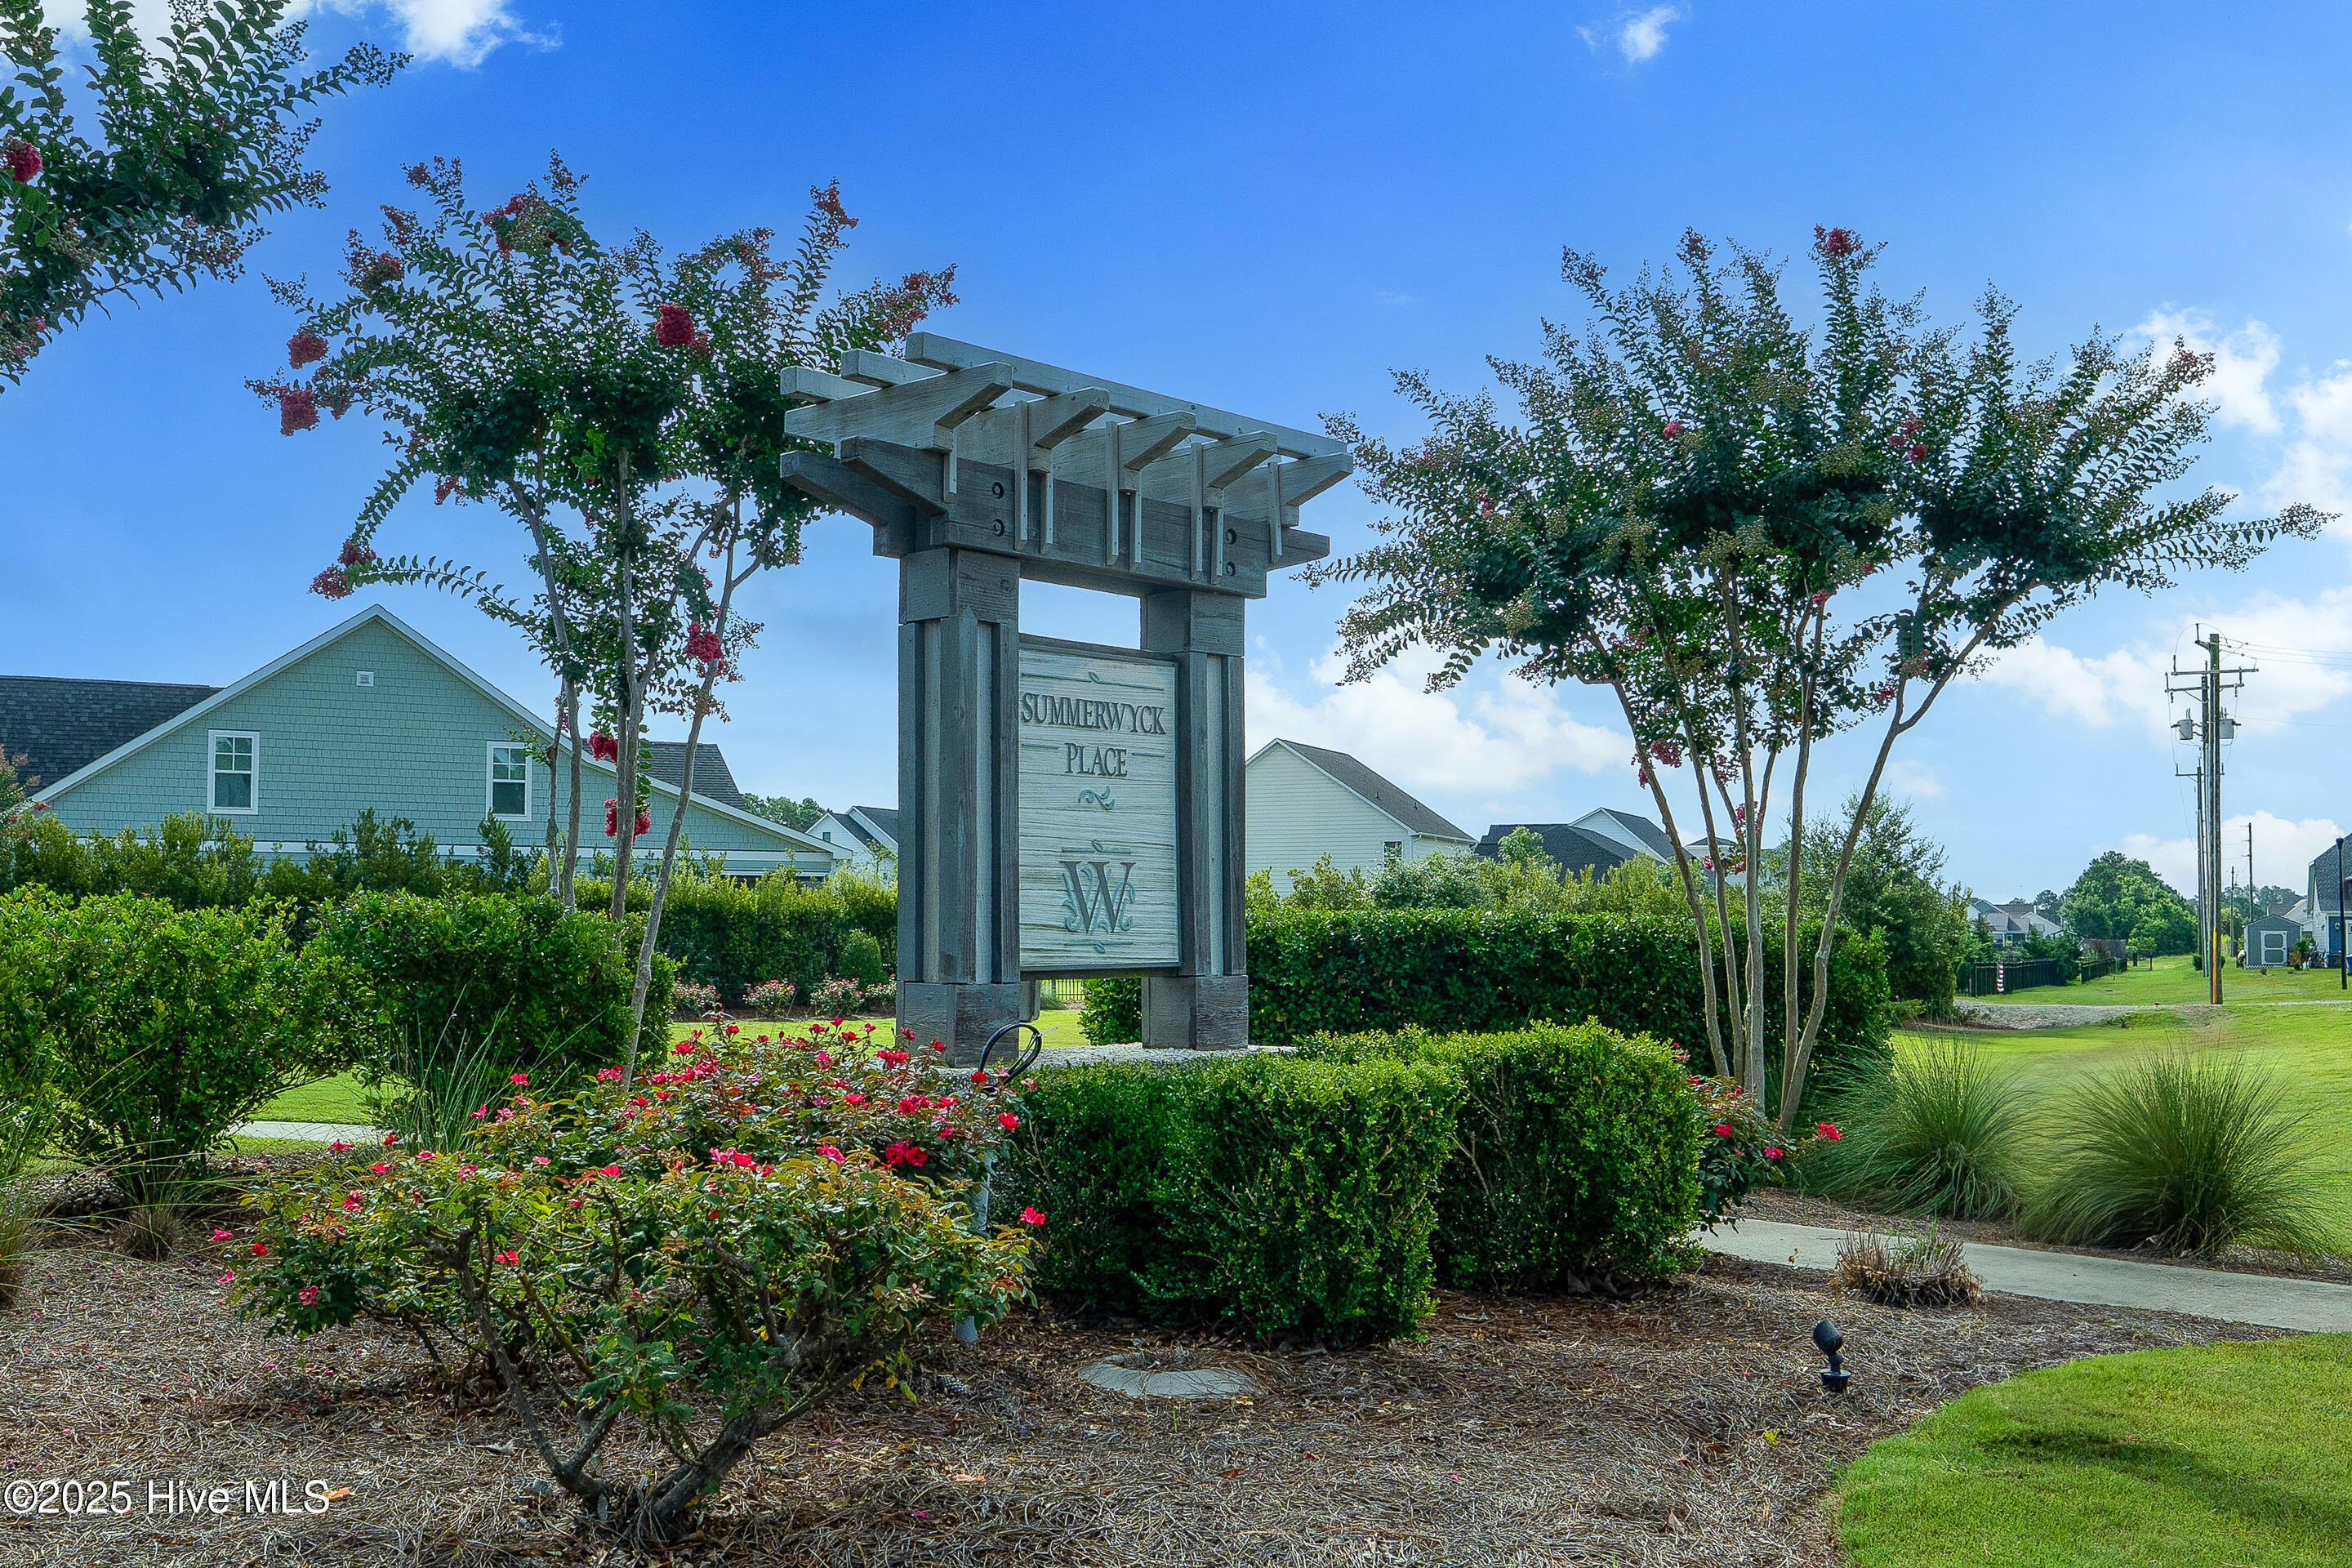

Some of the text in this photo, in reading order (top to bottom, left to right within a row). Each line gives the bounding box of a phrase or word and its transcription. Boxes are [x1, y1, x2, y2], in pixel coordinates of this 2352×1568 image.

[1021, 692, 1166, 735] SUMMERWYCK
[1064, 742, 1128, 777] PLACE
[1059, 860, 1137, 934] W
